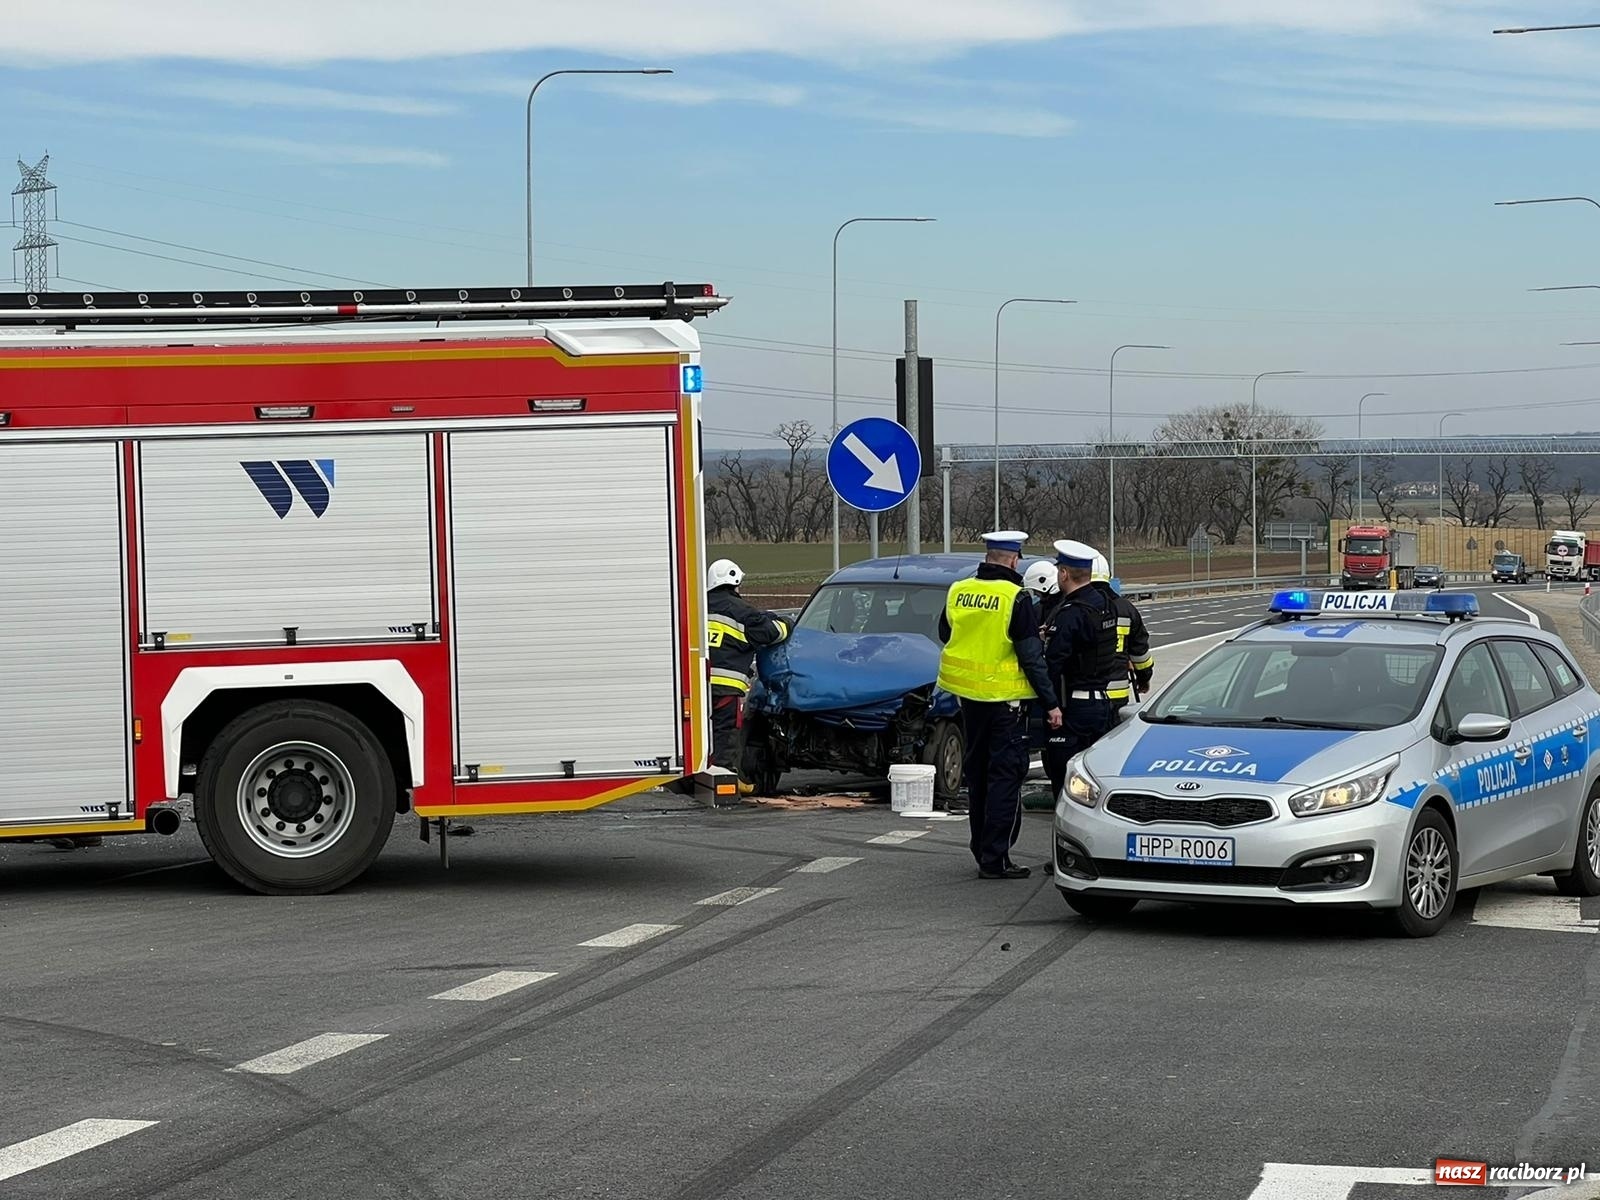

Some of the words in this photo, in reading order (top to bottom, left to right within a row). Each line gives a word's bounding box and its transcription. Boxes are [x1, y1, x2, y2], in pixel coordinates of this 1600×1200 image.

[955, 593, 1000, 610] POLICJA
[1324, 594, 1388, 609] POLICJA
[1147, 759, 1257, 776] POLICJA
[1477, 760, 1517, 794] POLICJA
[1140, 837, 1174, 857] HPP
[1181, 839, 1228, 859] R006
